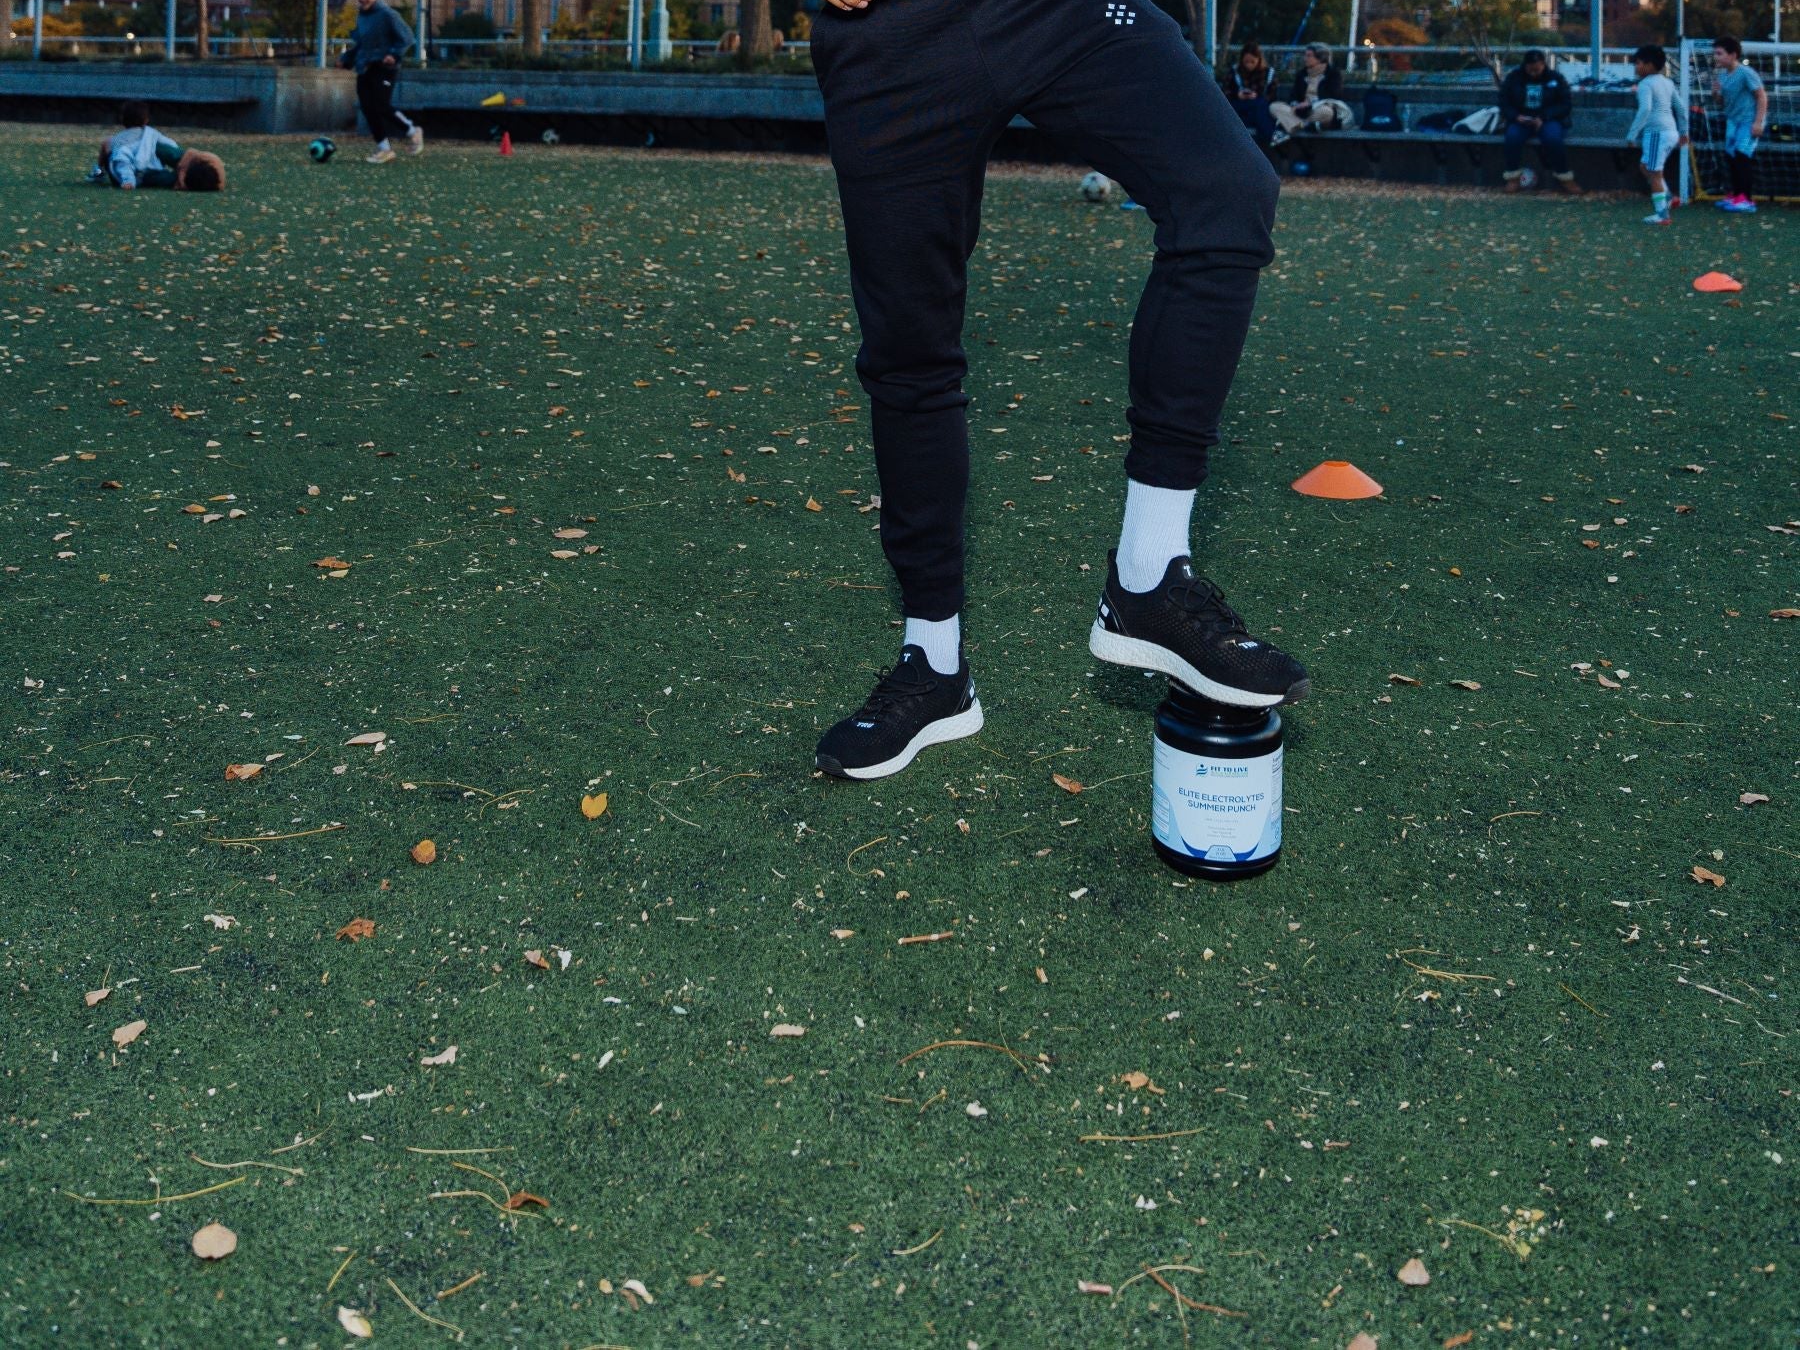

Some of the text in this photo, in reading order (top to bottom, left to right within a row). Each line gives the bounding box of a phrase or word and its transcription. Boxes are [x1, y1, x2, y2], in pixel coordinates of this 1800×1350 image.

[1178, 786, 1265, 804] ELITE ELECTROLYTES
[1187, 799, 1256, 813] SUMMER PUNCH
